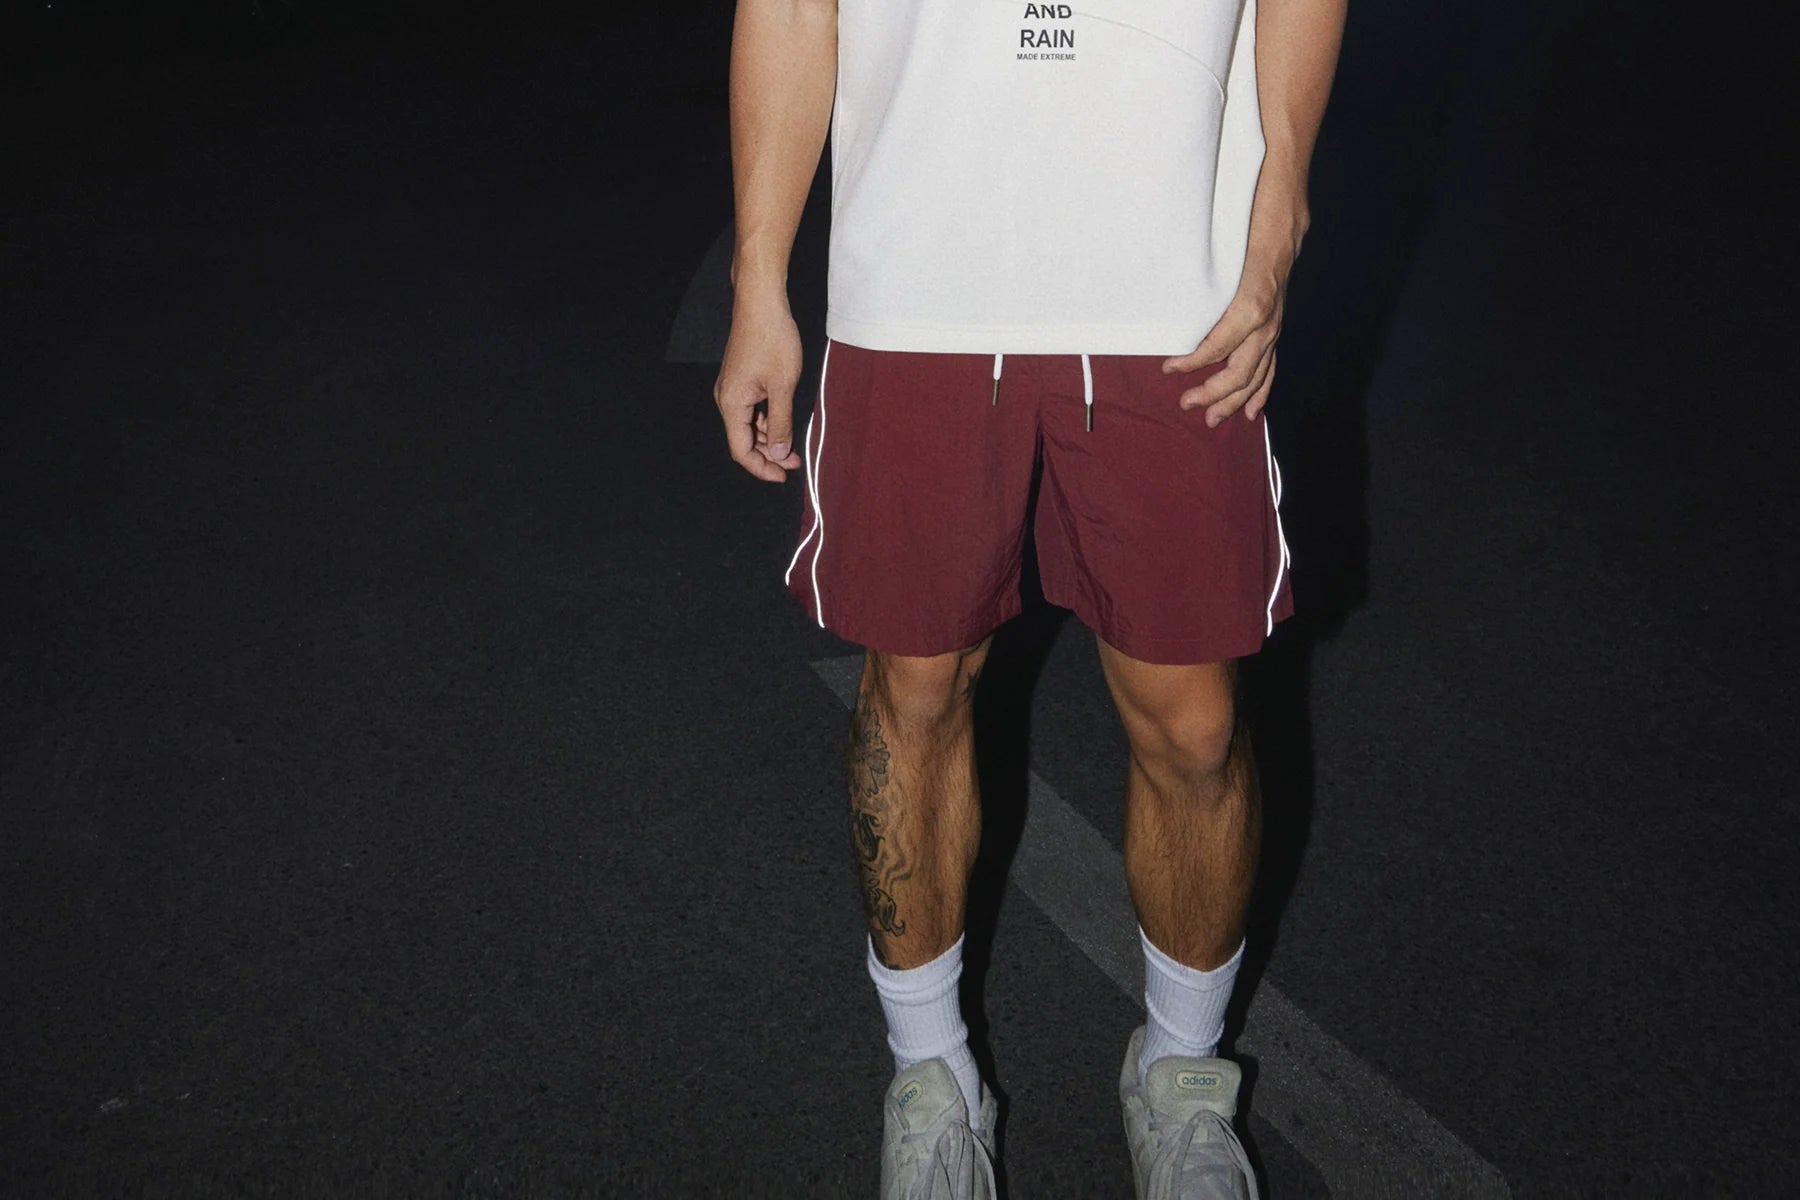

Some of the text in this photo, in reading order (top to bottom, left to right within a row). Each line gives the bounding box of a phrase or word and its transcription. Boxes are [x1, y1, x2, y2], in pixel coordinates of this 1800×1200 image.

[1023, 2, 1073, 19] AND
[1020, 29, 1075, 48] RAIN
[1016, 53, 1077, 61] MADE EXTREME
[1182, 1075, 1216, 1086] adidas
